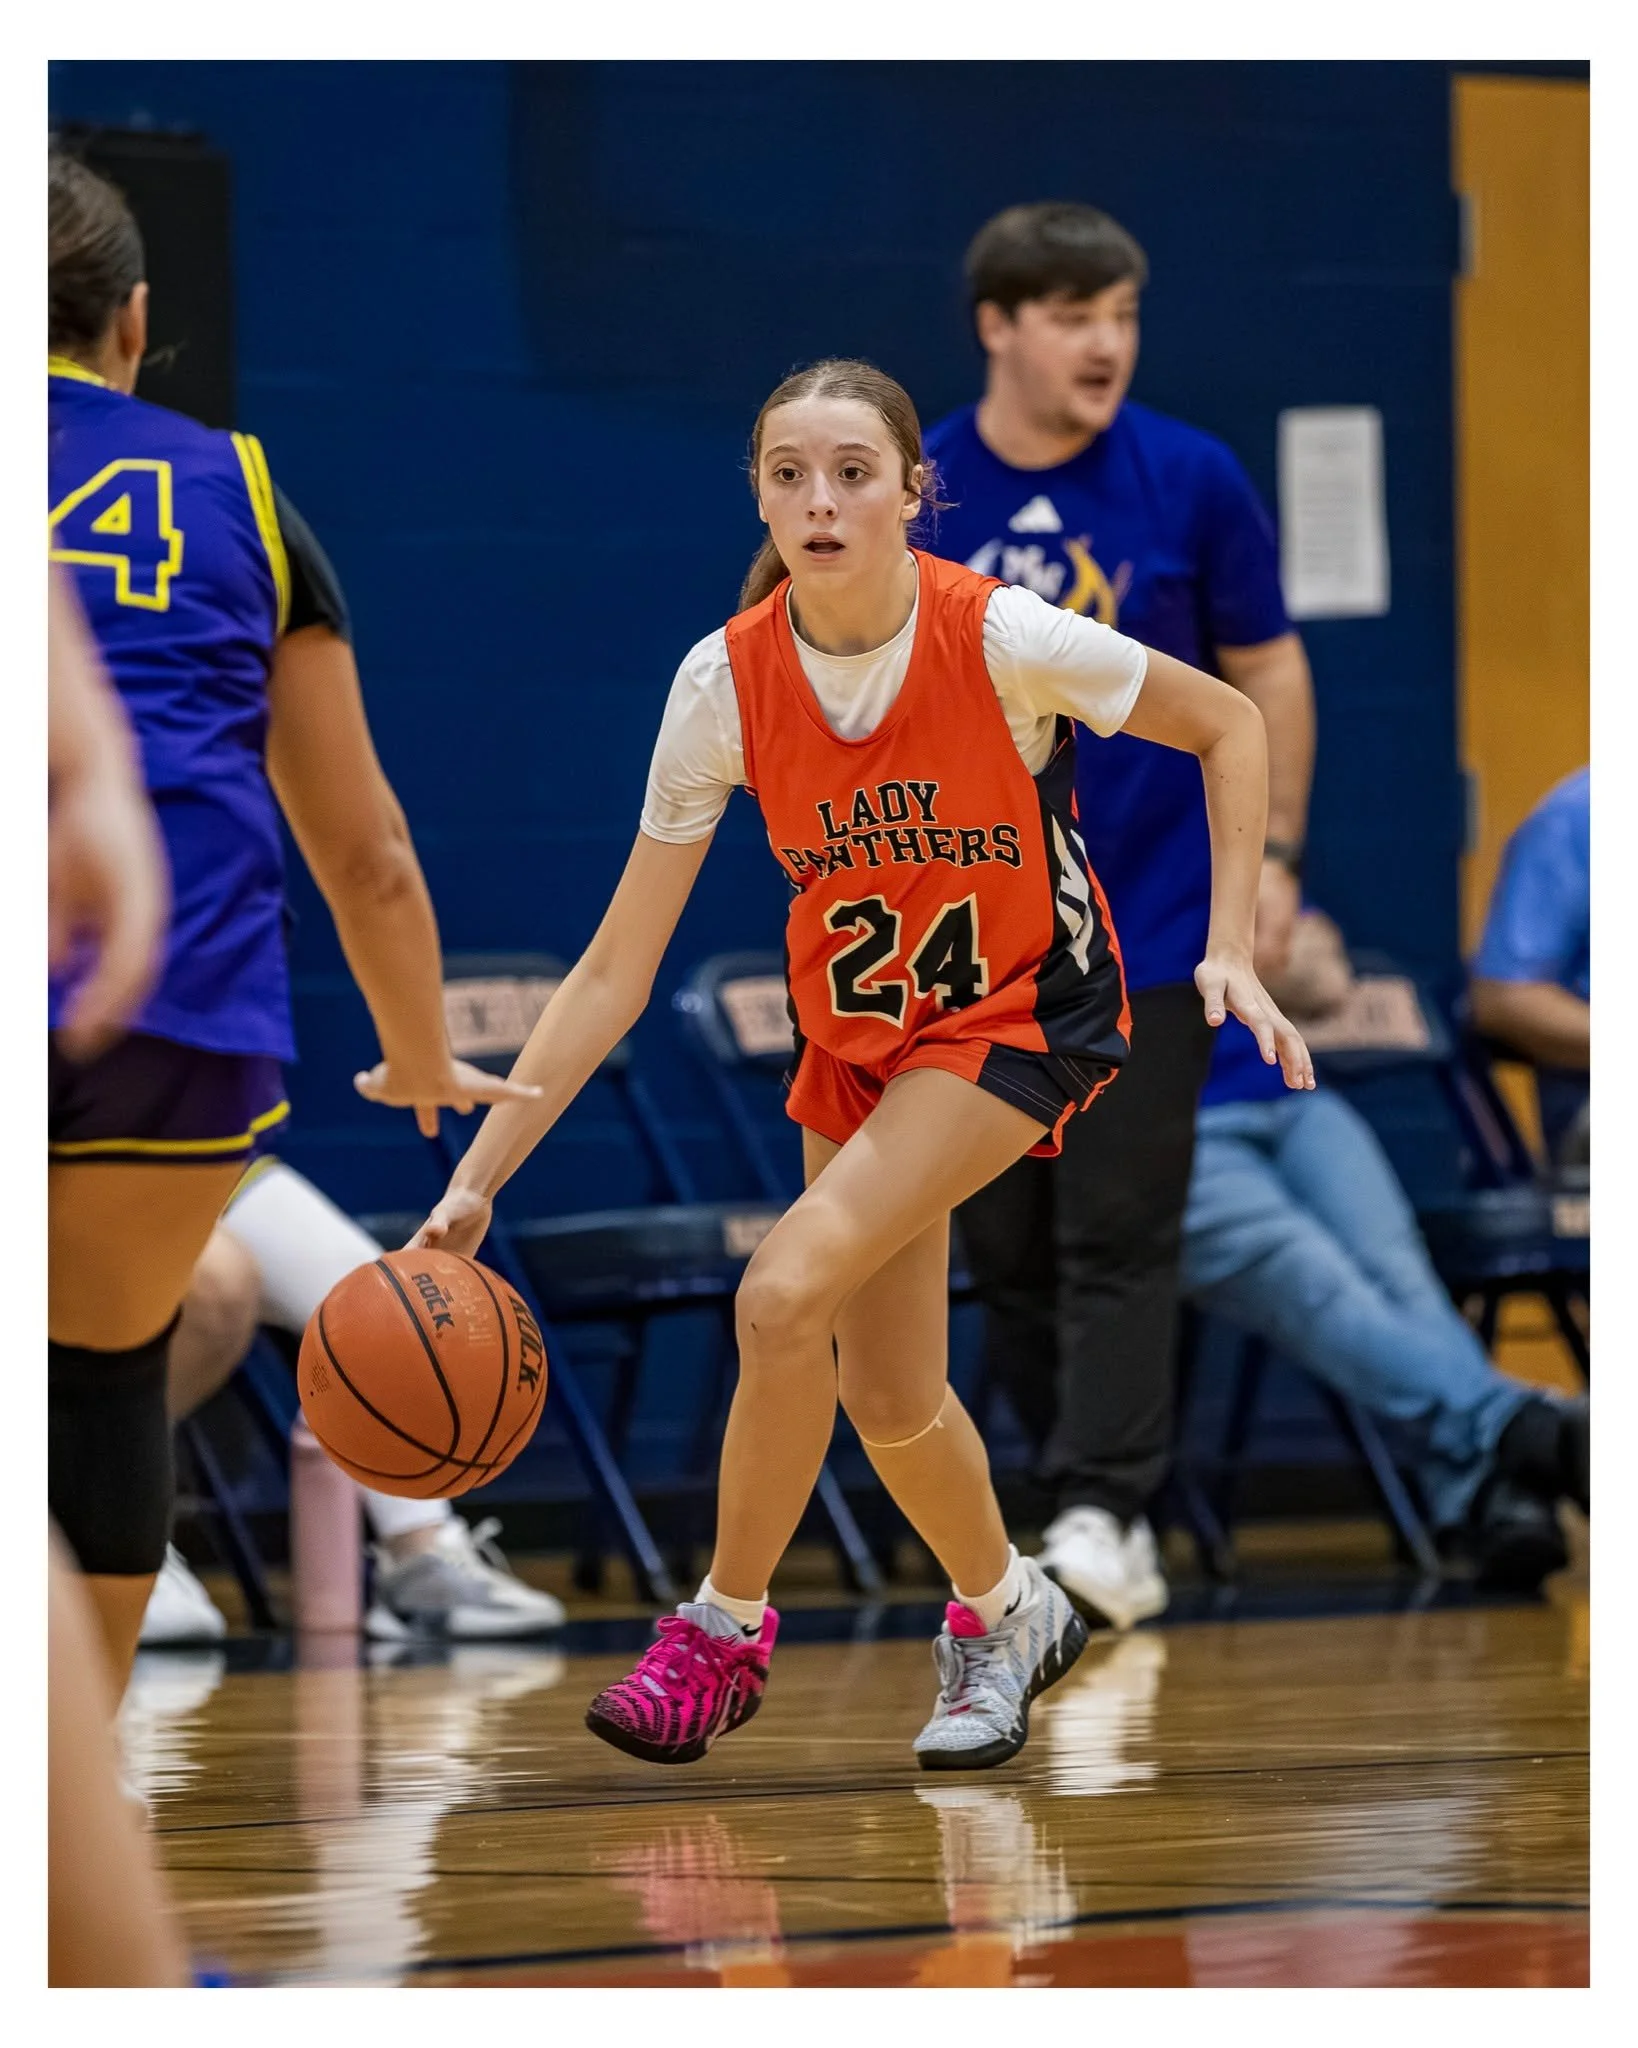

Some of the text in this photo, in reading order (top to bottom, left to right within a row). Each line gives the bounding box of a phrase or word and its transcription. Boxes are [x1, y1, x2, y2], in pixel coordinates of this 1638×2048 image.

[48, 458, 184, 612] 4
[780, 823, 1023, 879] PANTHERS
[816, 780, 939, 841] LADY
[823, 892, 990, 1029] 24
